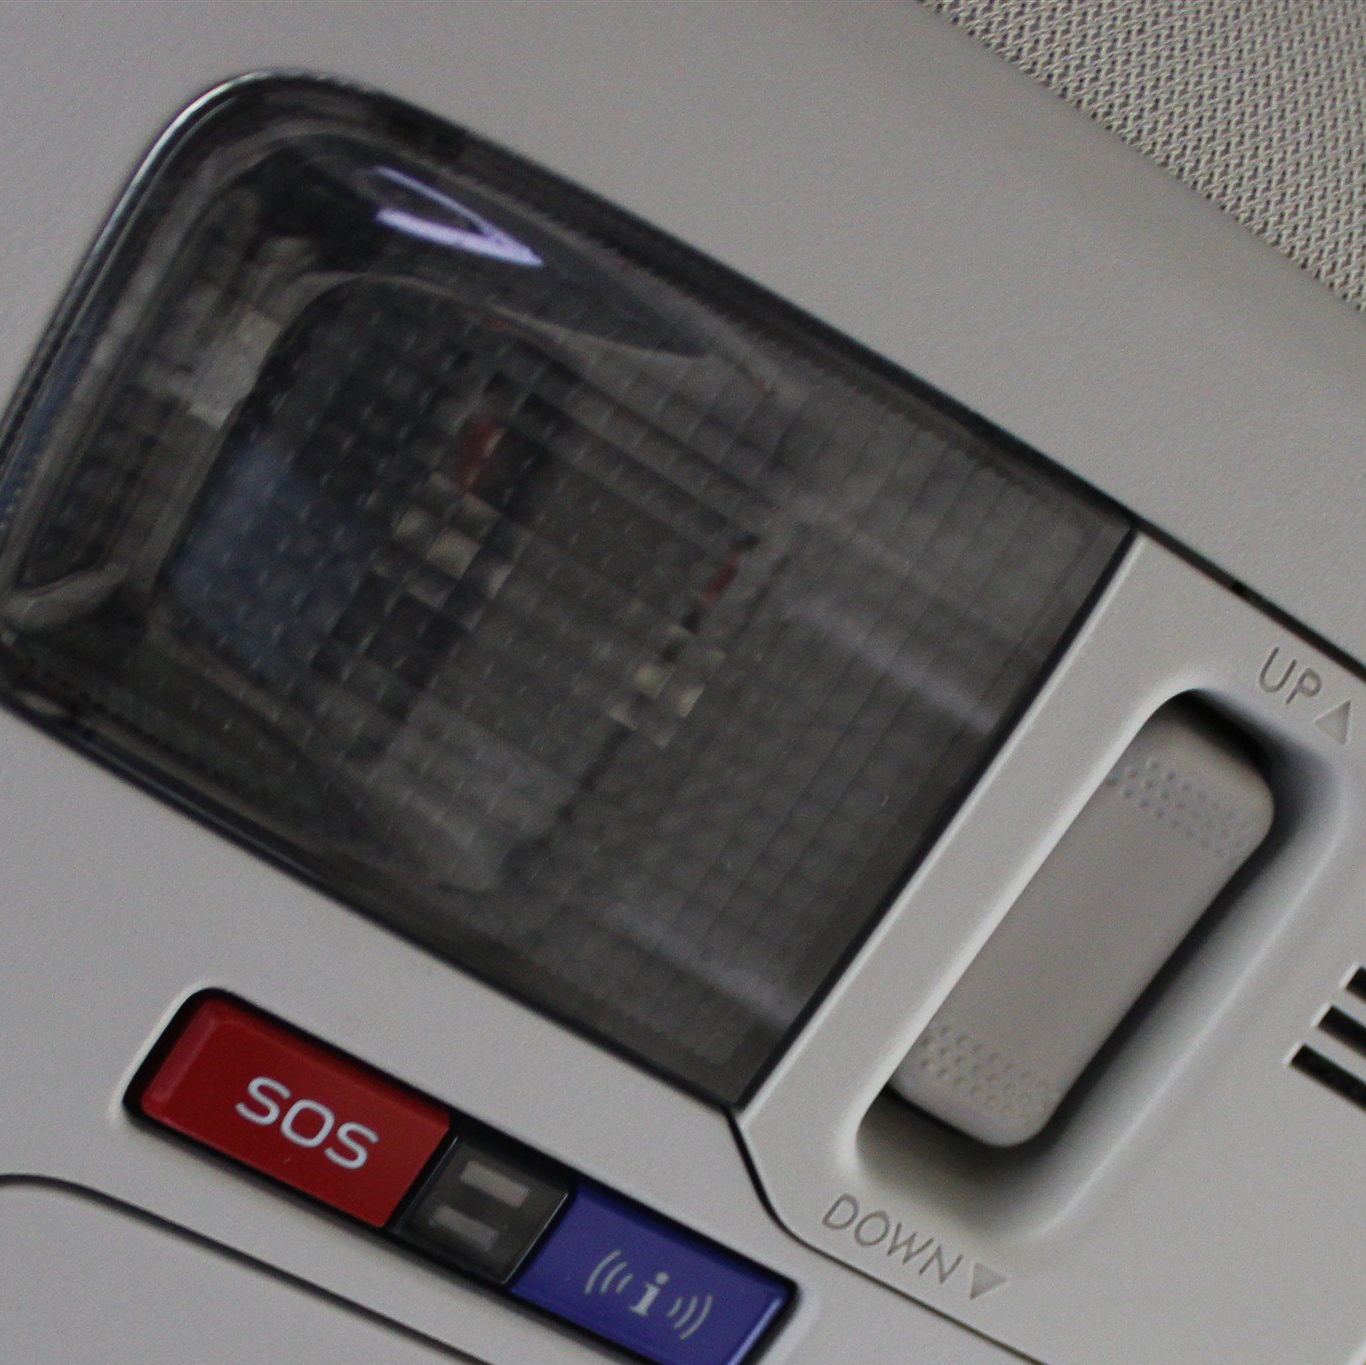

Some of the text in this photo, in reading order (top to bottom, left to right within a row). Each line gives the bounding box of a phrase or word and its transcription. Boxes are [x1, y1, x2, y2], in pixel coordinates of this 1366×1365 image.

[1257, 646, 1322, 706] UP
[235, 1076, 379, 1169] SOS
[822, 1193, 962, 1283] DOWN
